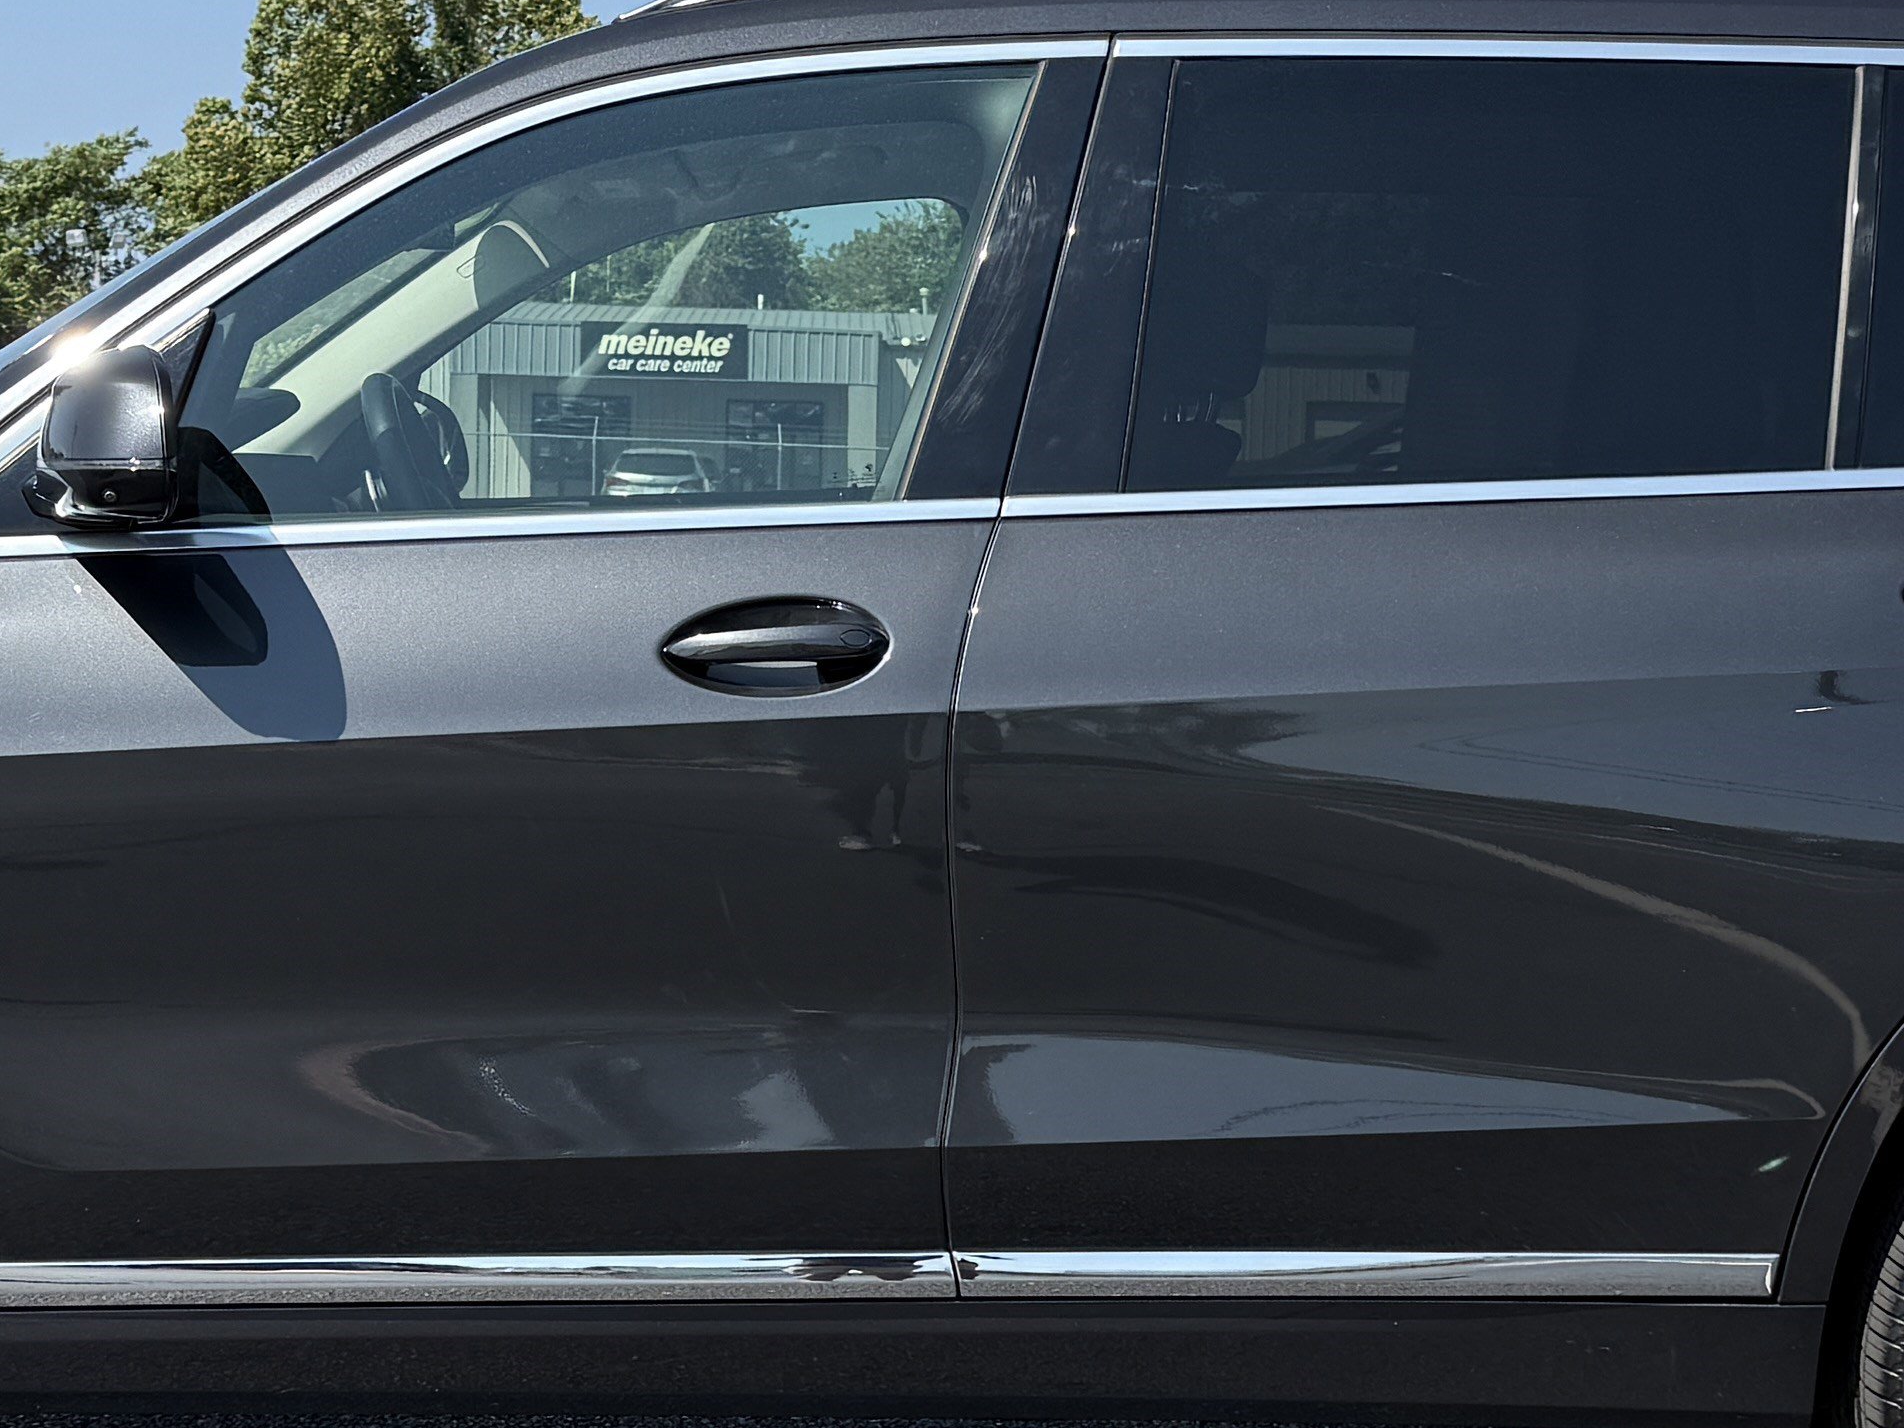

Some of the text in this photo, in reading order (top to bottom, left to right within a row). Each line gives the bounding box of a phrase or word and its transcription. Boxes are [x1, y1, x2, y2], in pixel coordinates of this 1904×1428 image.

[597, 328, 732, 357] meineke
[607, 358, 724, 373] car care center
